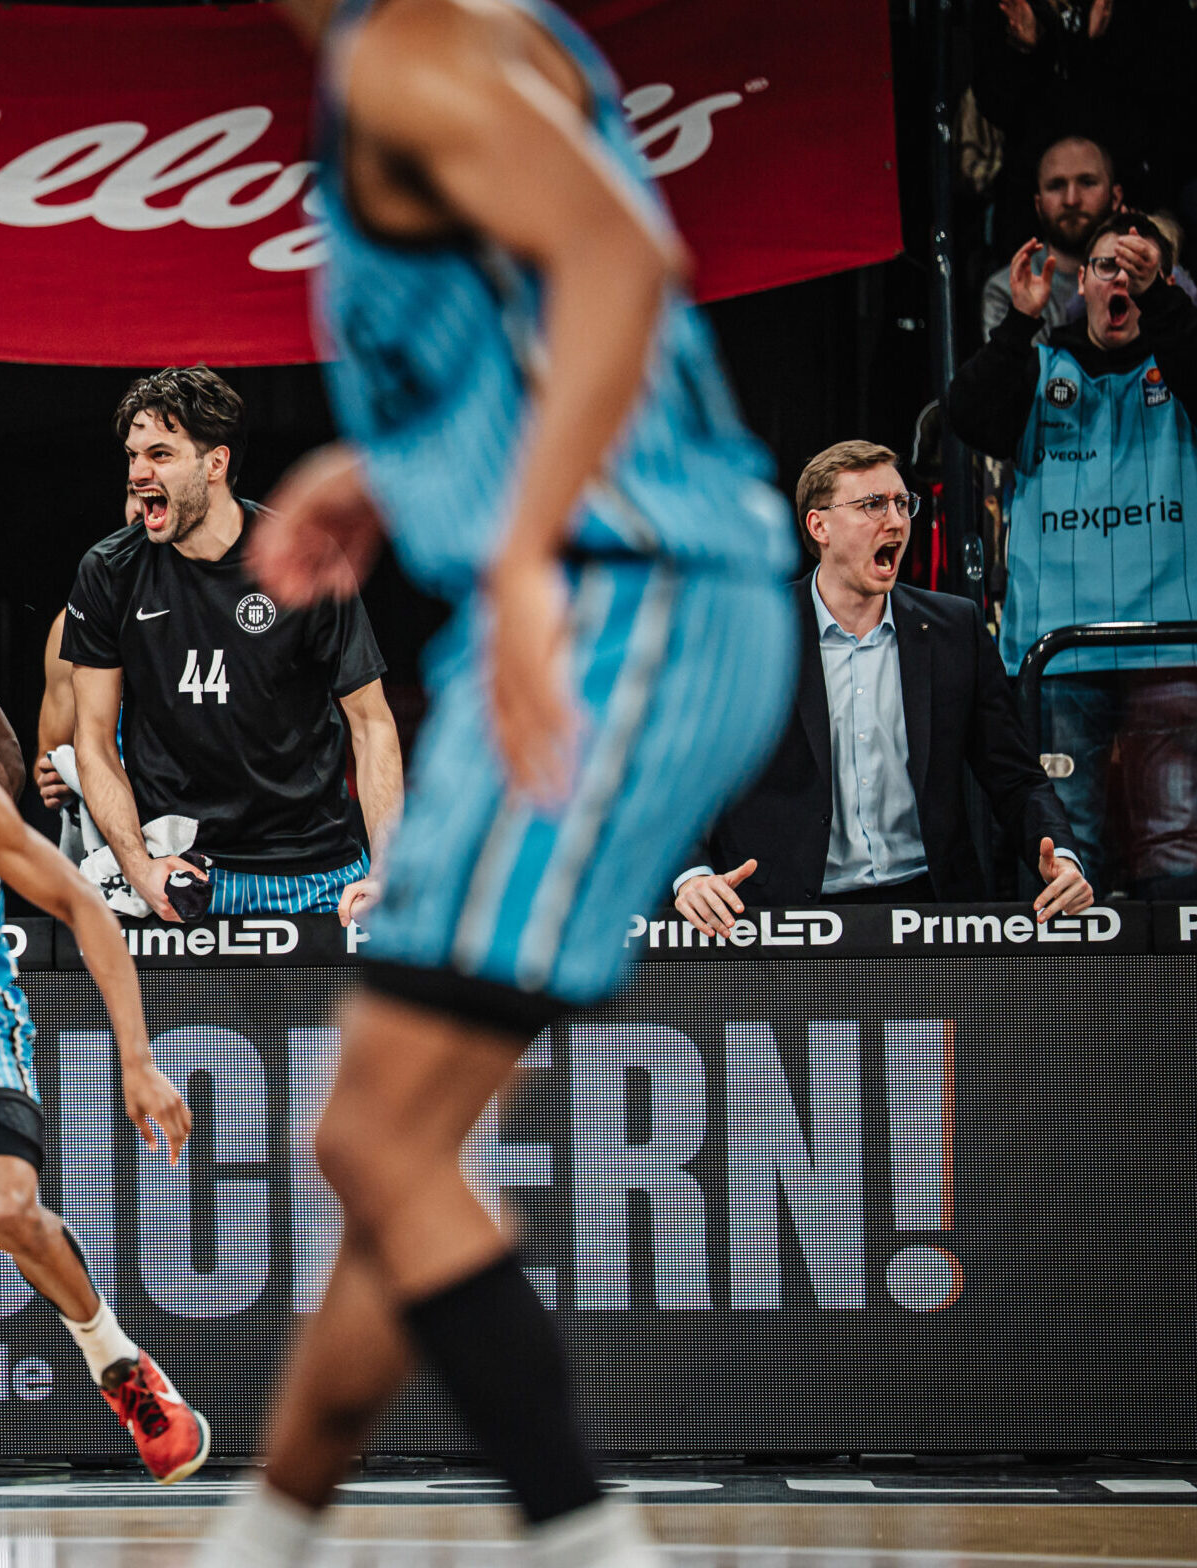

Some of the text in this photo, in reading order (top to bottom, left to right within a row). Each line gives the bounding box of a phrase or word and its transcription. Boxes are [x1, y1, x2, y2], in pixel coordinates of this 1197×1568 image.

[1049, 449, 1098, 462] VEOLIA
[1041, 494, 1183, 538] nexperia
[178, 649, 230, 704] 44
[890, 906, 1122, 944] PrimeLED
